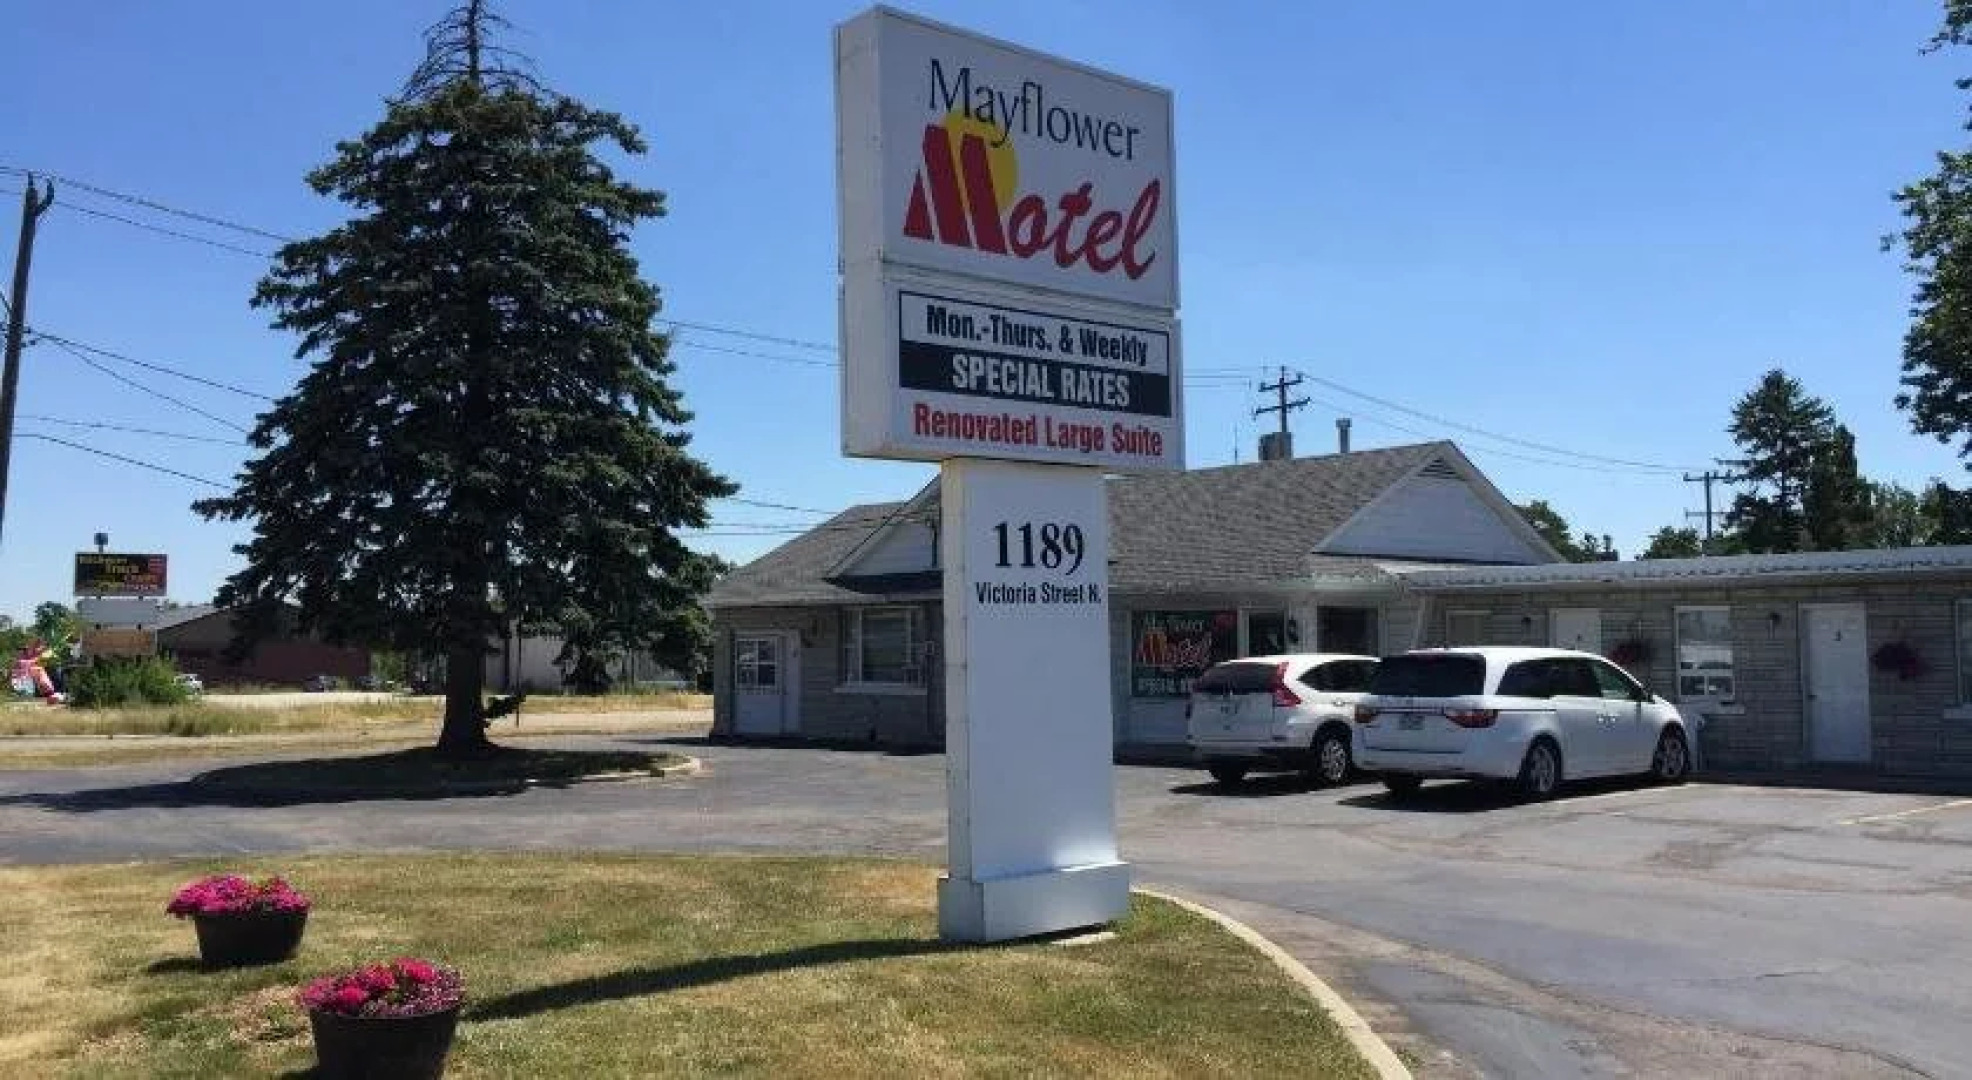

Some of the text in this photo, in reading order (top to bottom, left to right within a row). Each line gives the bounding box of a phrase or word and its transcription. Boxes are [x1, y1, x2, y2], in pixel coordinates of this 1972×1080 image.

[928, 58, 1140, 161] Mayflower
[903, 123, 1161, 281] Motel
[926, 303, 1149, 367] Mon.-Thurs. & Weekly
[952, 354, 1130, 408] SPECIAL RATES
[913, 402, 1163, 457] Renovated Large Suite
[993, 521, 1084, 576] 1189
[976, 581, 1102, 604] Victoria Street N.
